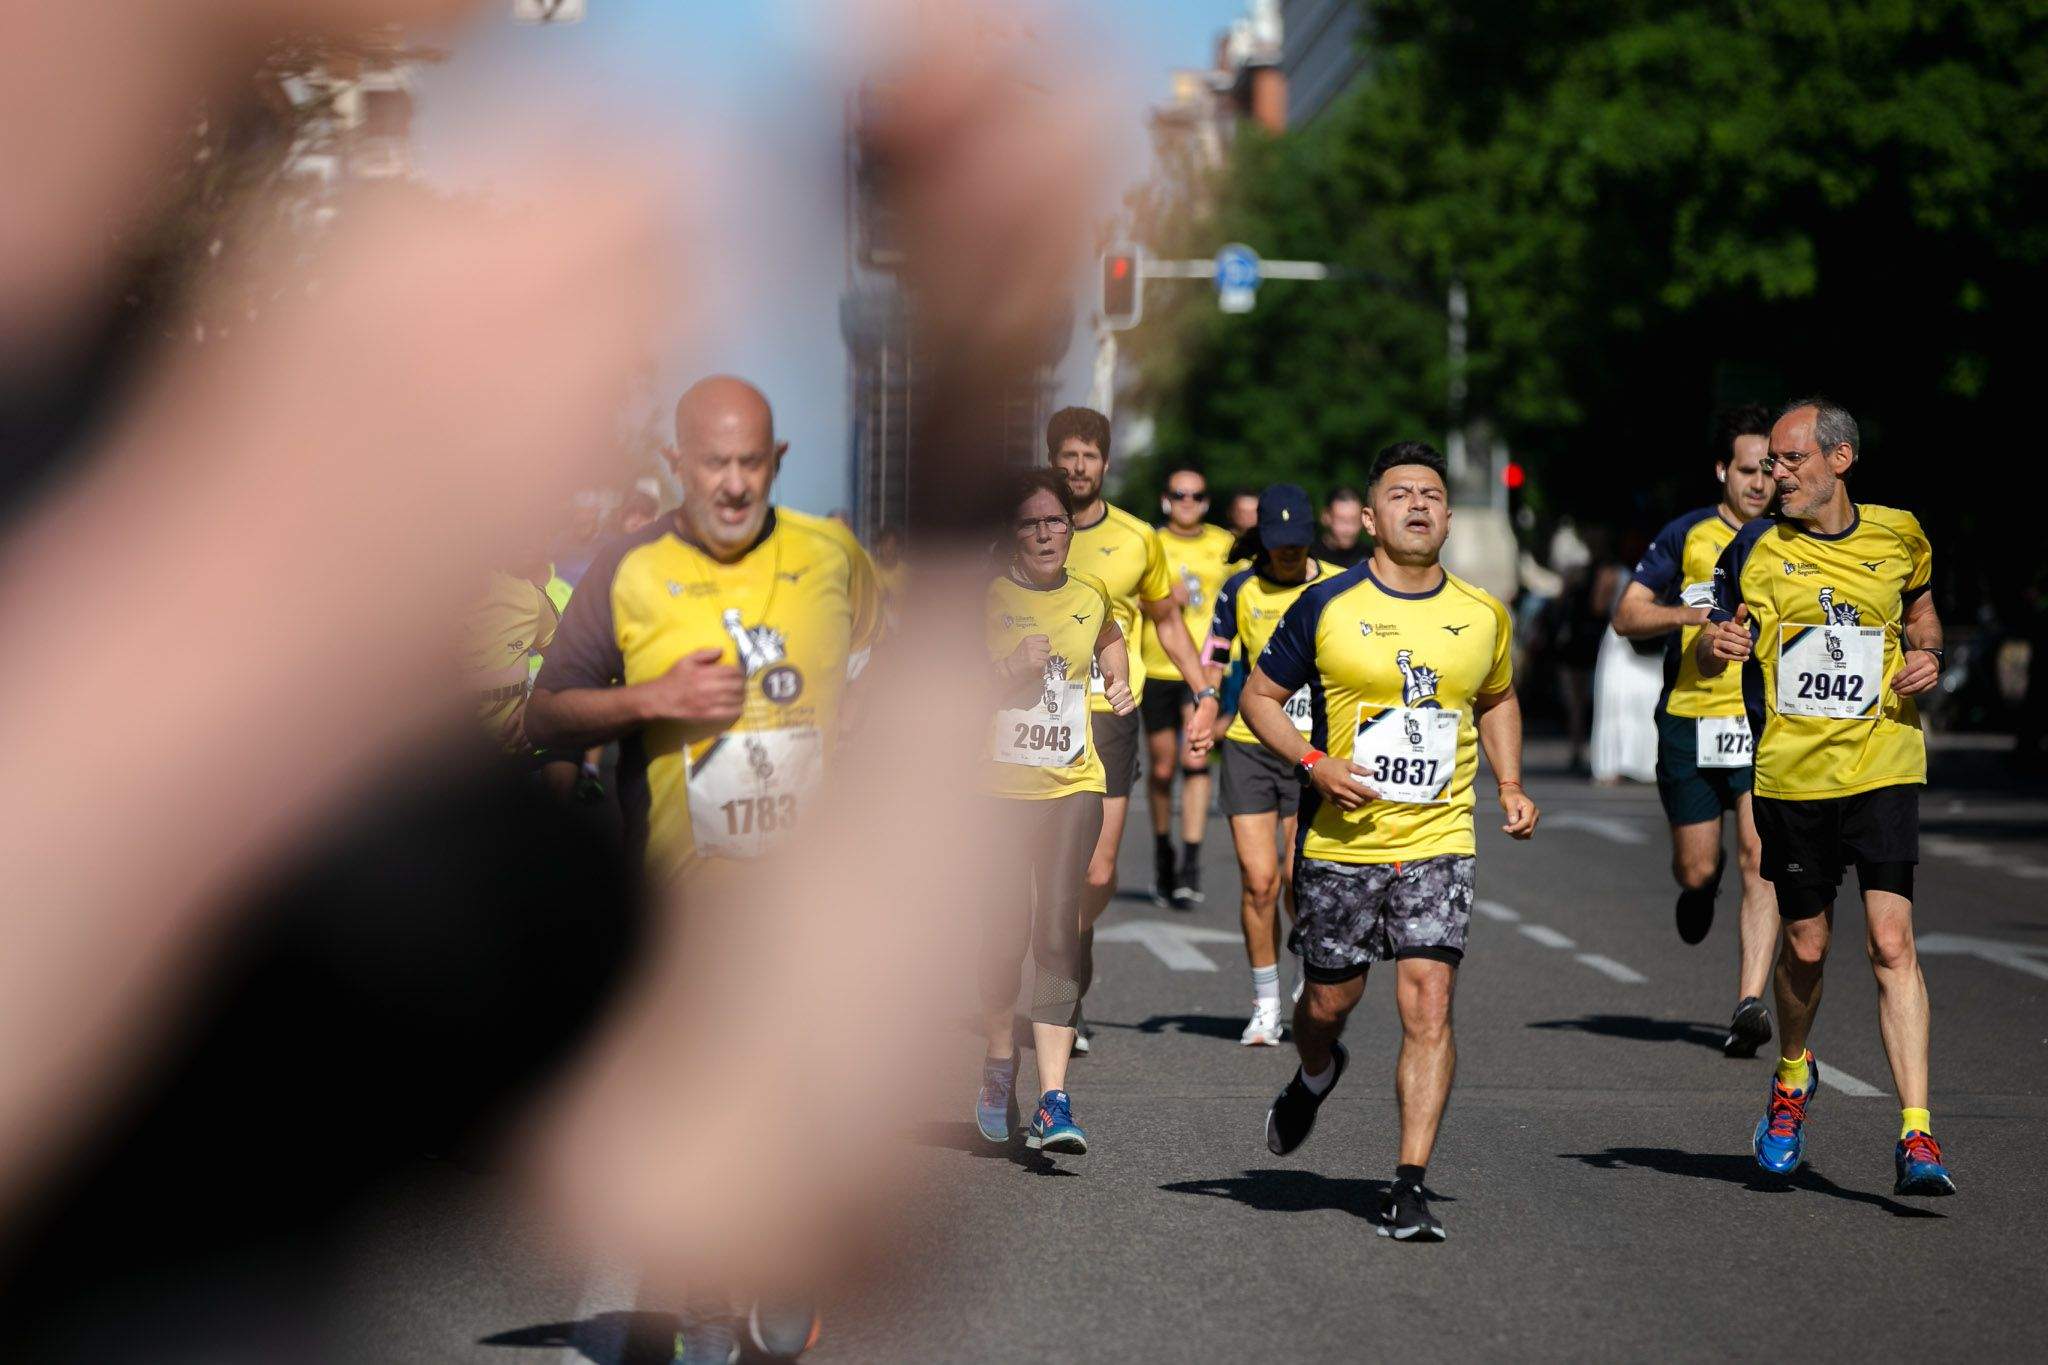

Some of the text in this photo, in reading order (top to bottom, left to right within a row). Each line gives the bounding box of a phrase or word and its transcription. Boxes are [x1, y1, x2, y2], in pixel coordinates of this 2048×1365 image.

[768, 670, 797, 698] 13
[1798, 672, 1864, 701] 2942
[1013, 723, 1071, 751] 2943
[1374, 755, 1439, 786] 3837
[721, 794, 798, 836] 1783
